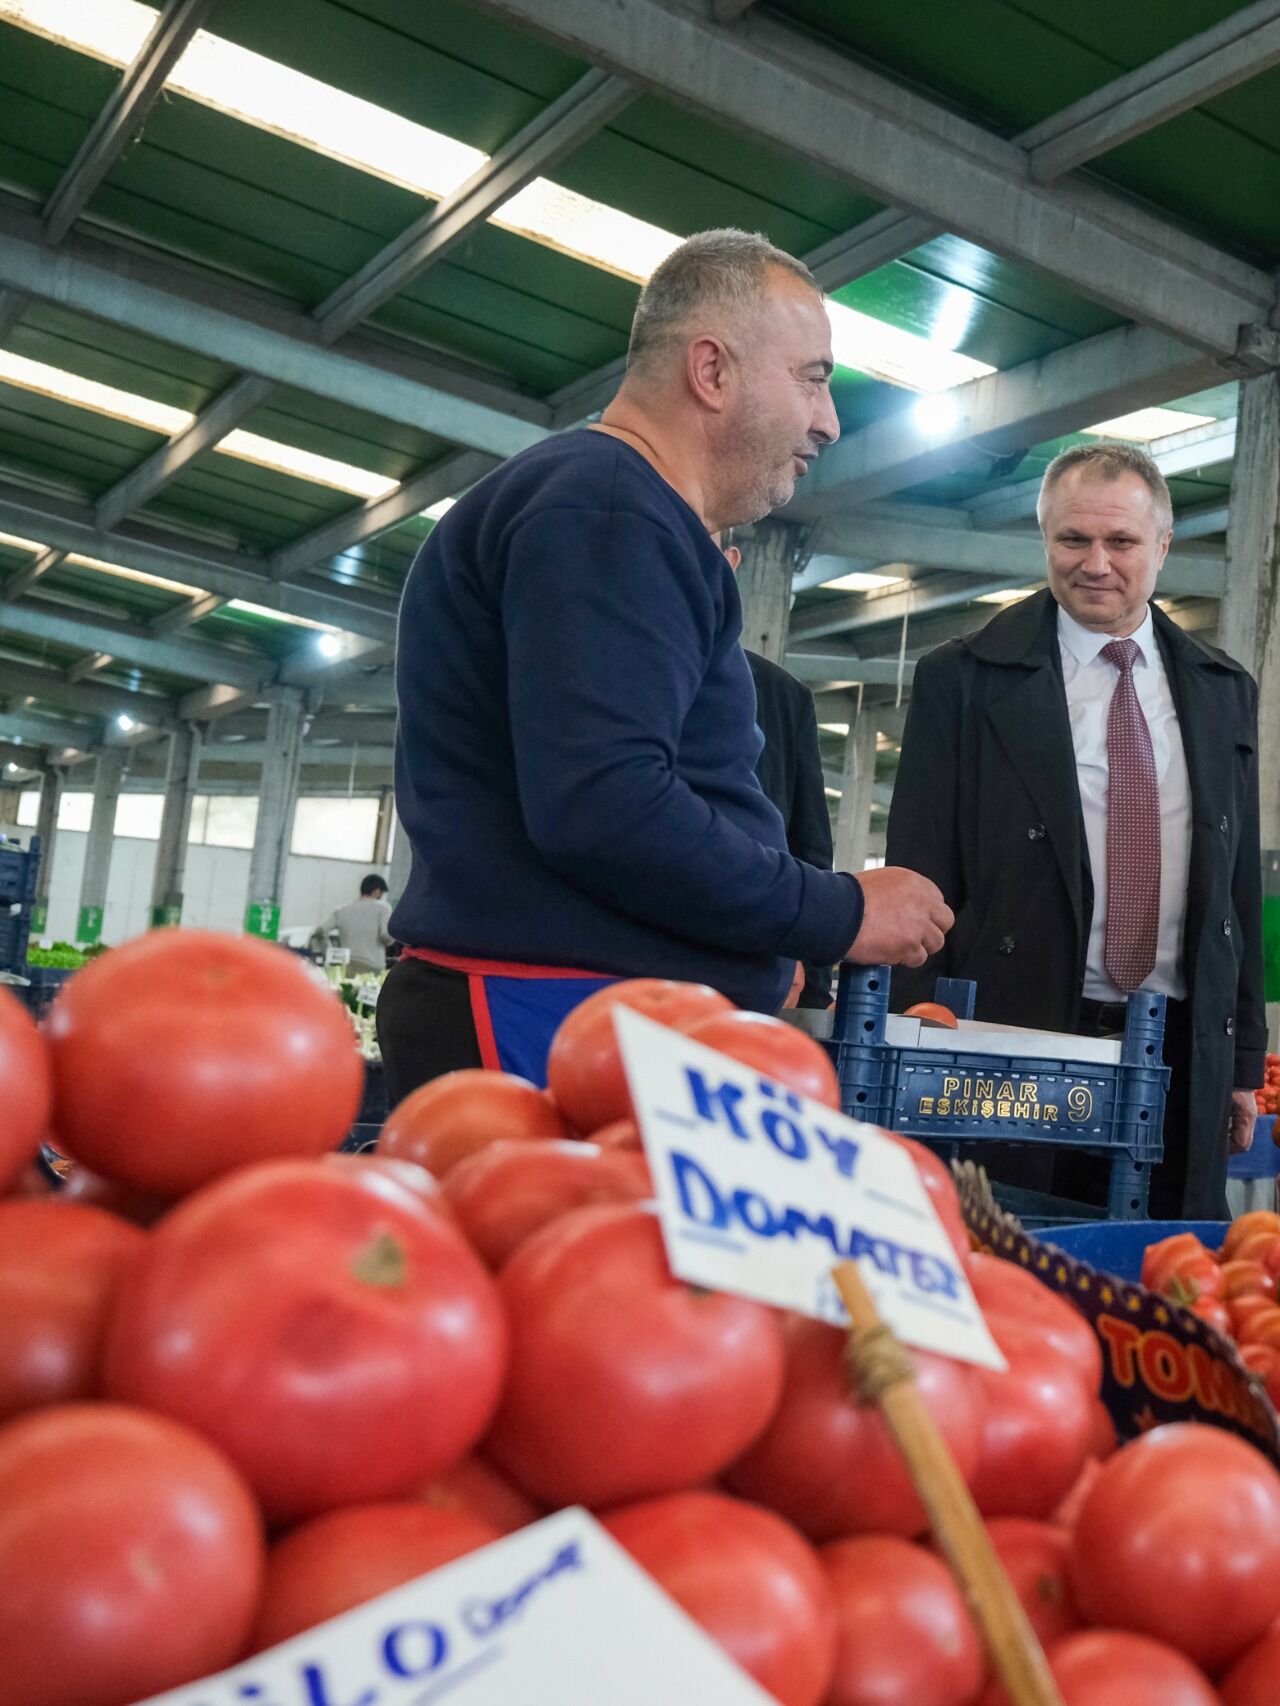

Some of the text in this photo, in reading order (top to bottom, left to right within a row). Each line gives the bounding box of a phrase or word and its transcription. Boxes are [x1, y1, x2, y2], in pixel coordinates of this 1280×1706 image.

[943, 1077, 1038, 1103] PINAR
[1067, 1086, 1093, 1123] 9
[684, 1065, 863, 1180] KÖY
